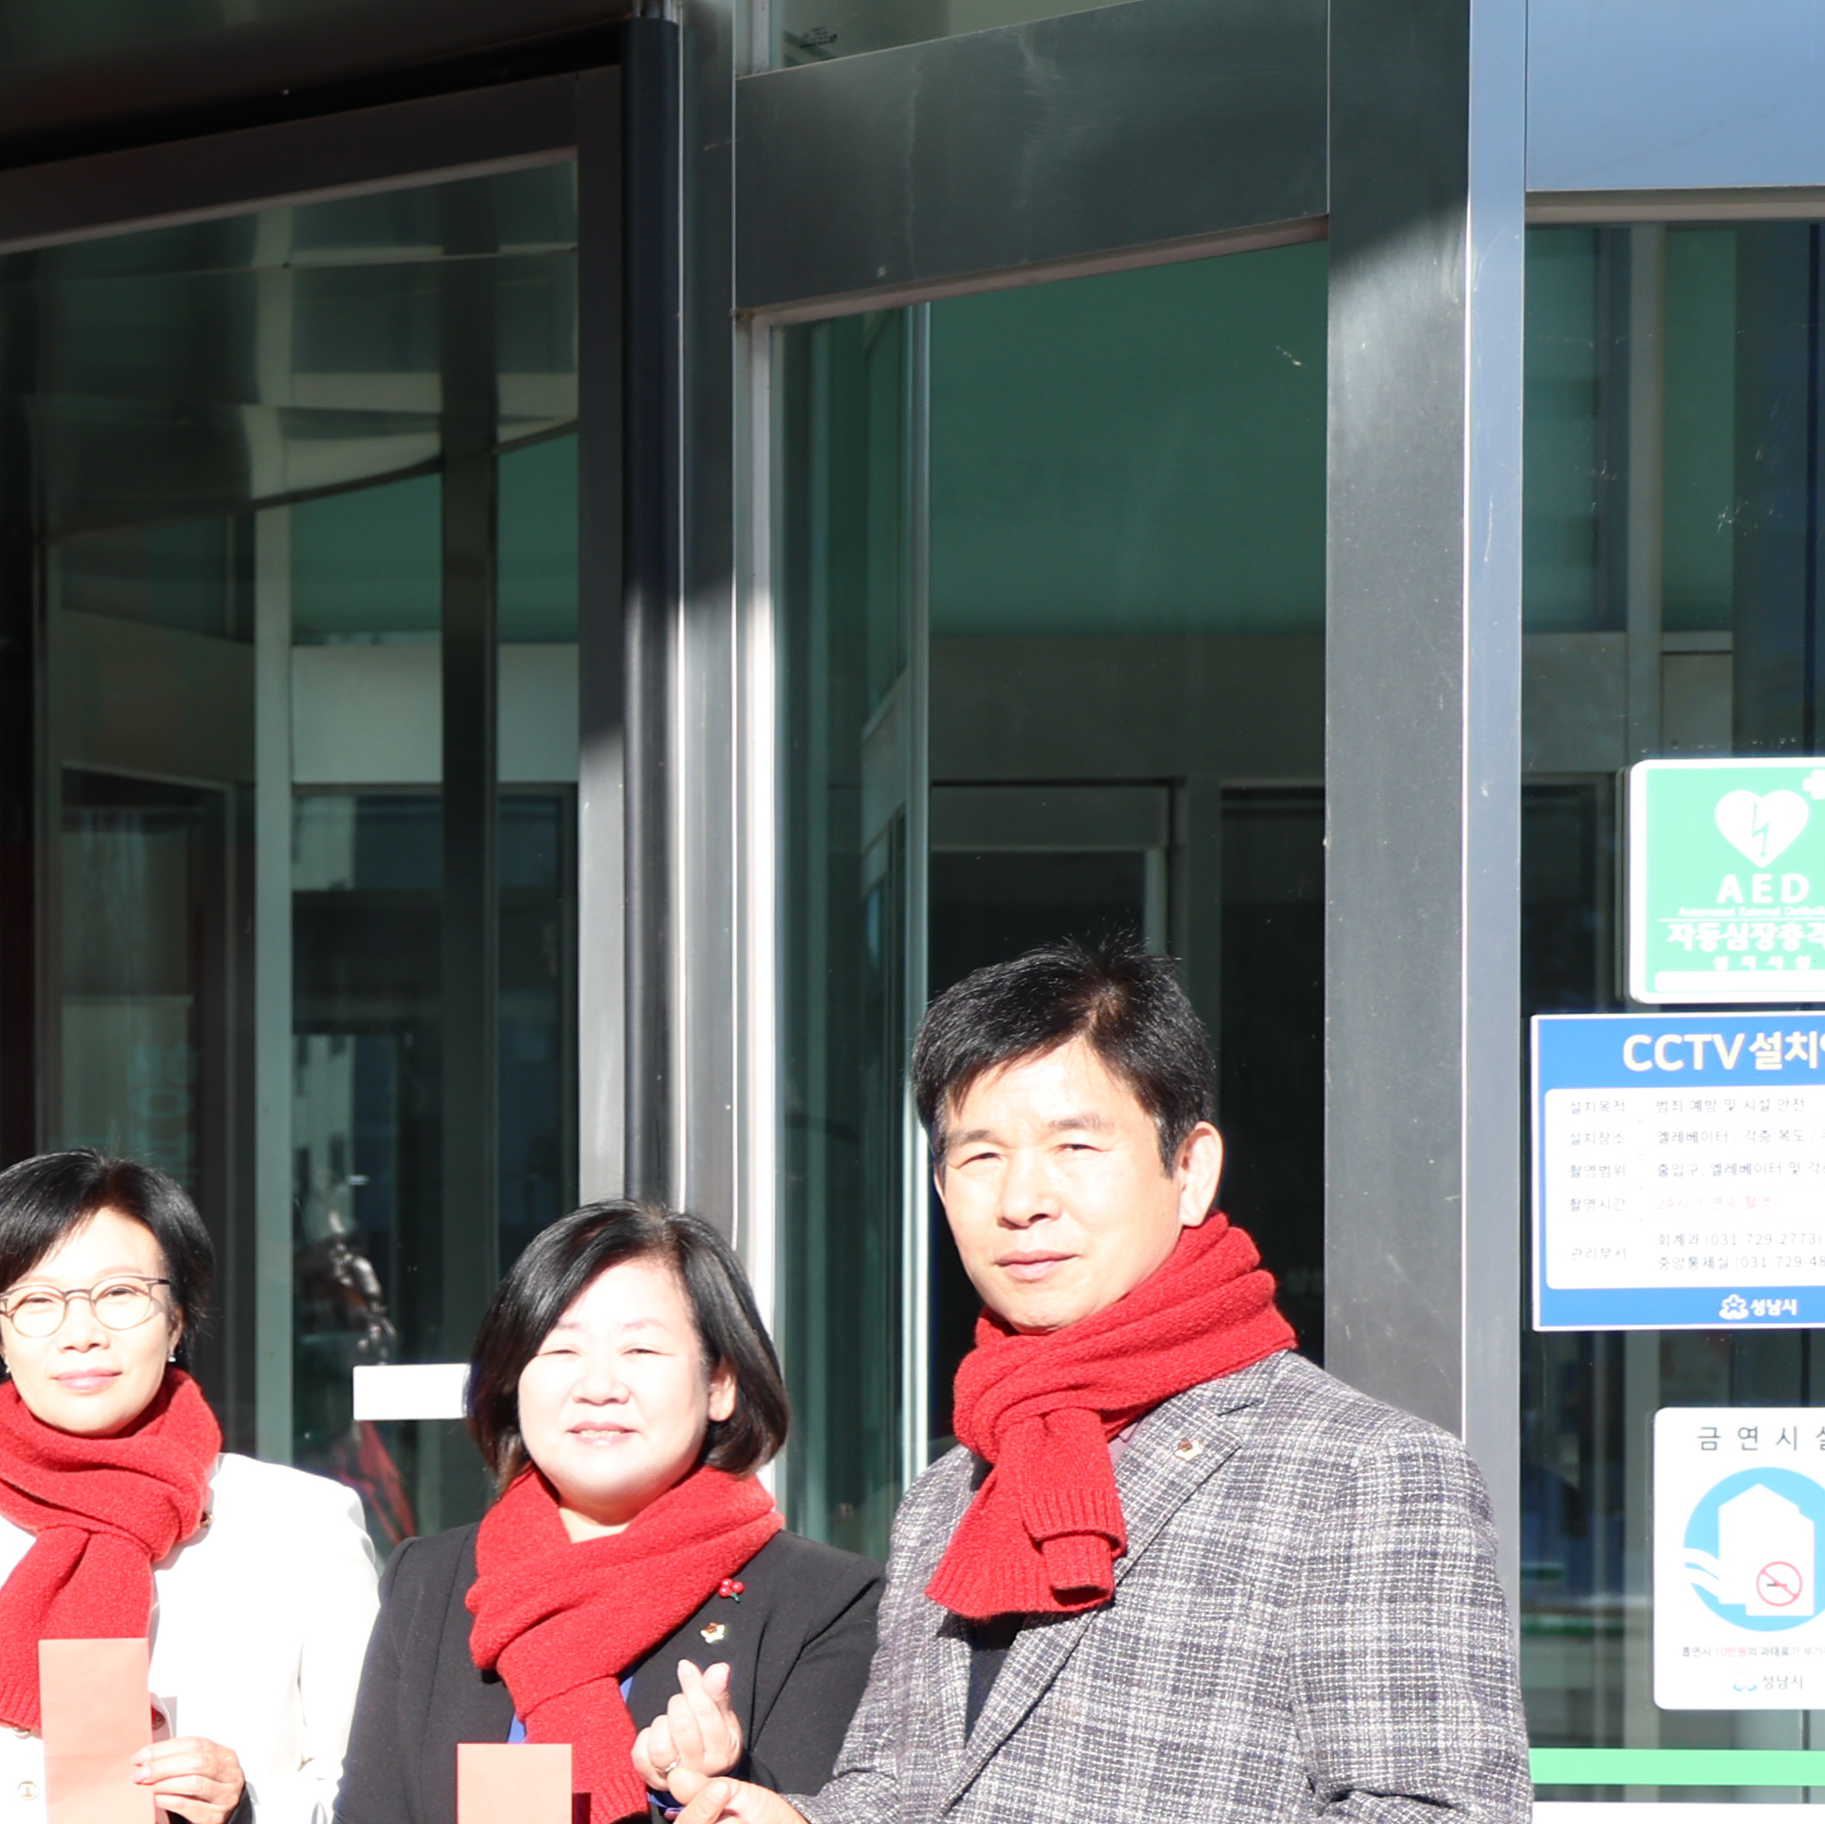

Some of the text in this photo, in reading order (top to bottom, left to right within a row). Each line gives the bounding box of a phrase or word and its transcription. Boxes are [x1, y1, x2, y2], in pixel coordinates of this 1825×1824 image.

[1717, 873, 1809, 903] AED
[1624, 1031, 1825, 1071] CCTV 설치
[1656, 1100, 1682, 1113] 범죄
[1691, 1100, 1716, 1112] 예방
[1744, 1098, 1770, 1112] 시설
[1777, 1098, 1804, 1111] 안전
[1570, 1132, 1623, 1145] 설치장소
[1779, 1130, 1804, 1142] 복도
[1809, 1162, 1825, 1174] 각
[1570, 1198, 1625, 1211] 촬영시간
[1657, 1197, 1703, 1210] 24시간
[1750, 1299, 1796, 1316] 성남시
[1762, 1675, 1803, 1690] 성남시
